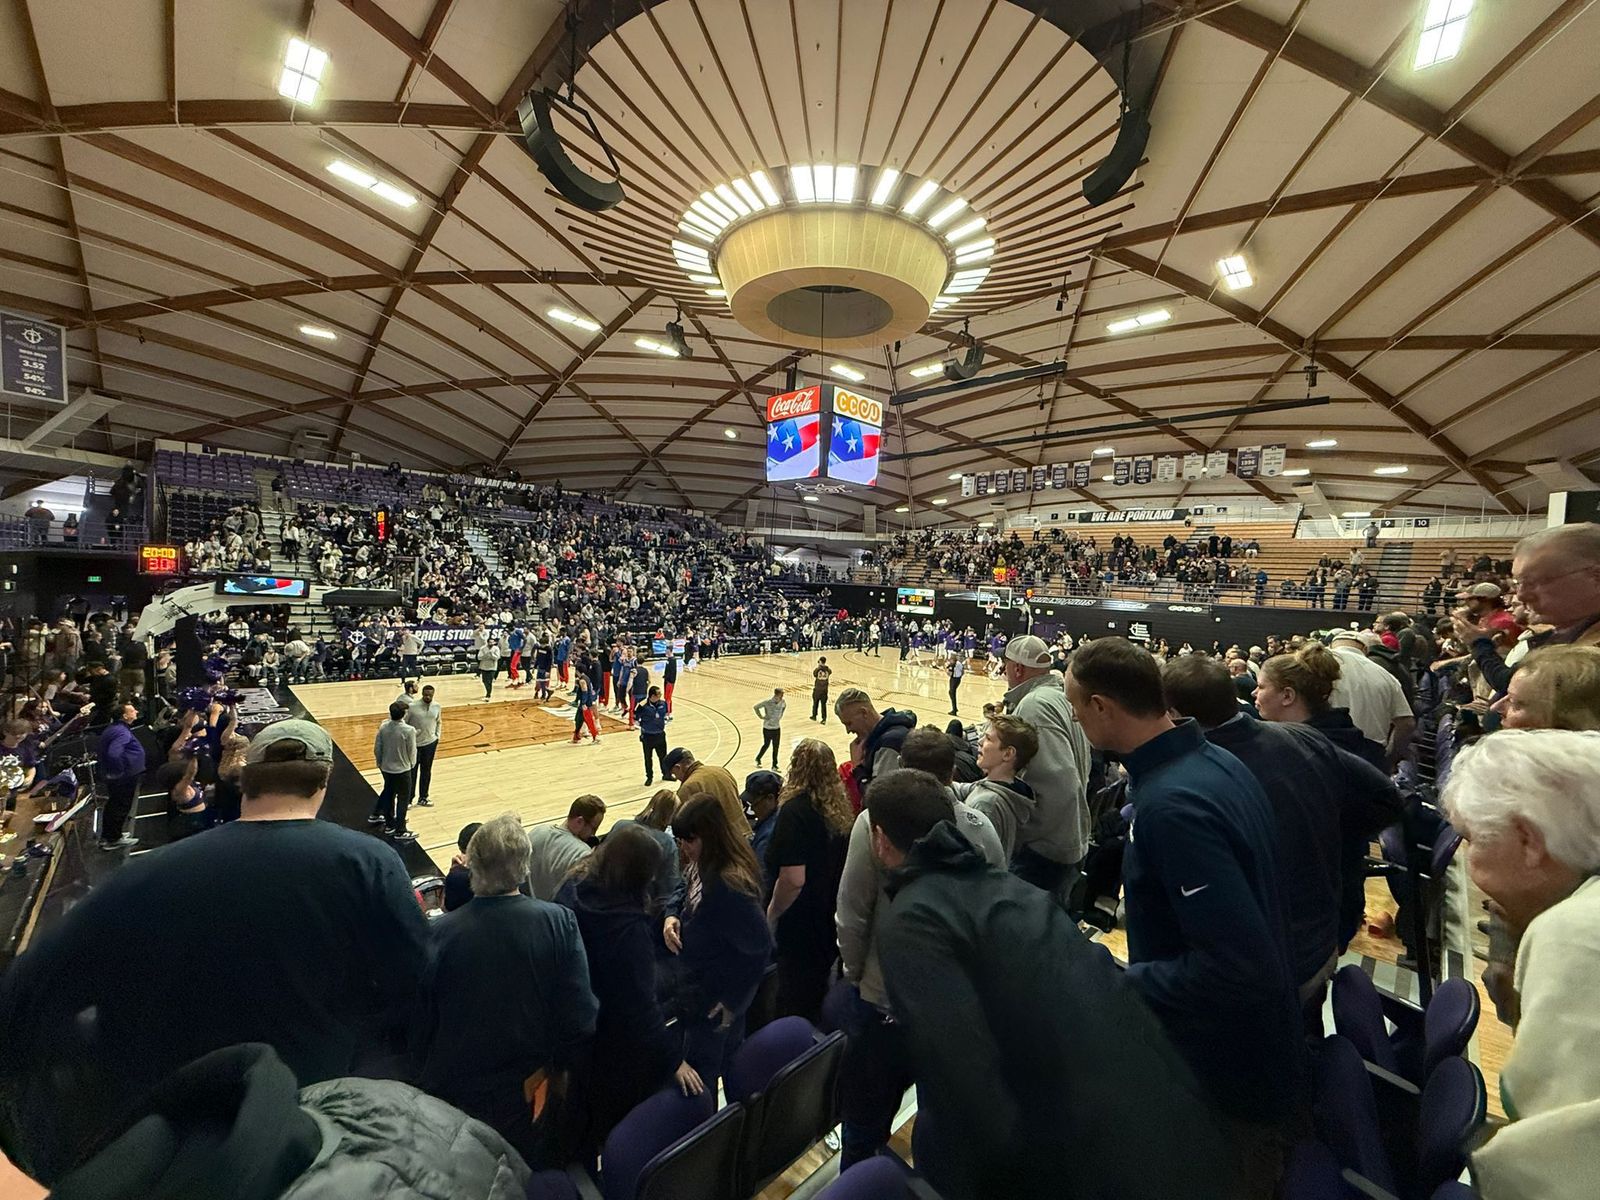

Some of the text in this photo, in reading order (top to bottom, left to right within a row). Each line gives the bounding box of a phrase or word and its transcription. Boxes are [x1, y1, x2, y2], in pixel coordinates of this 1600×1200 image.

[22, 360, 45, 370] 3.52
[23, 373, 45, 383] 54%
[24, 386, 47, 396] 94%
[1091, 509, 1175, 522] WE ARE PORTLAND
[1417, 519, 1428, 527] 10
[143, 547, 176, 558] 20:00
[415, 629, 446, 641] PRIDE
